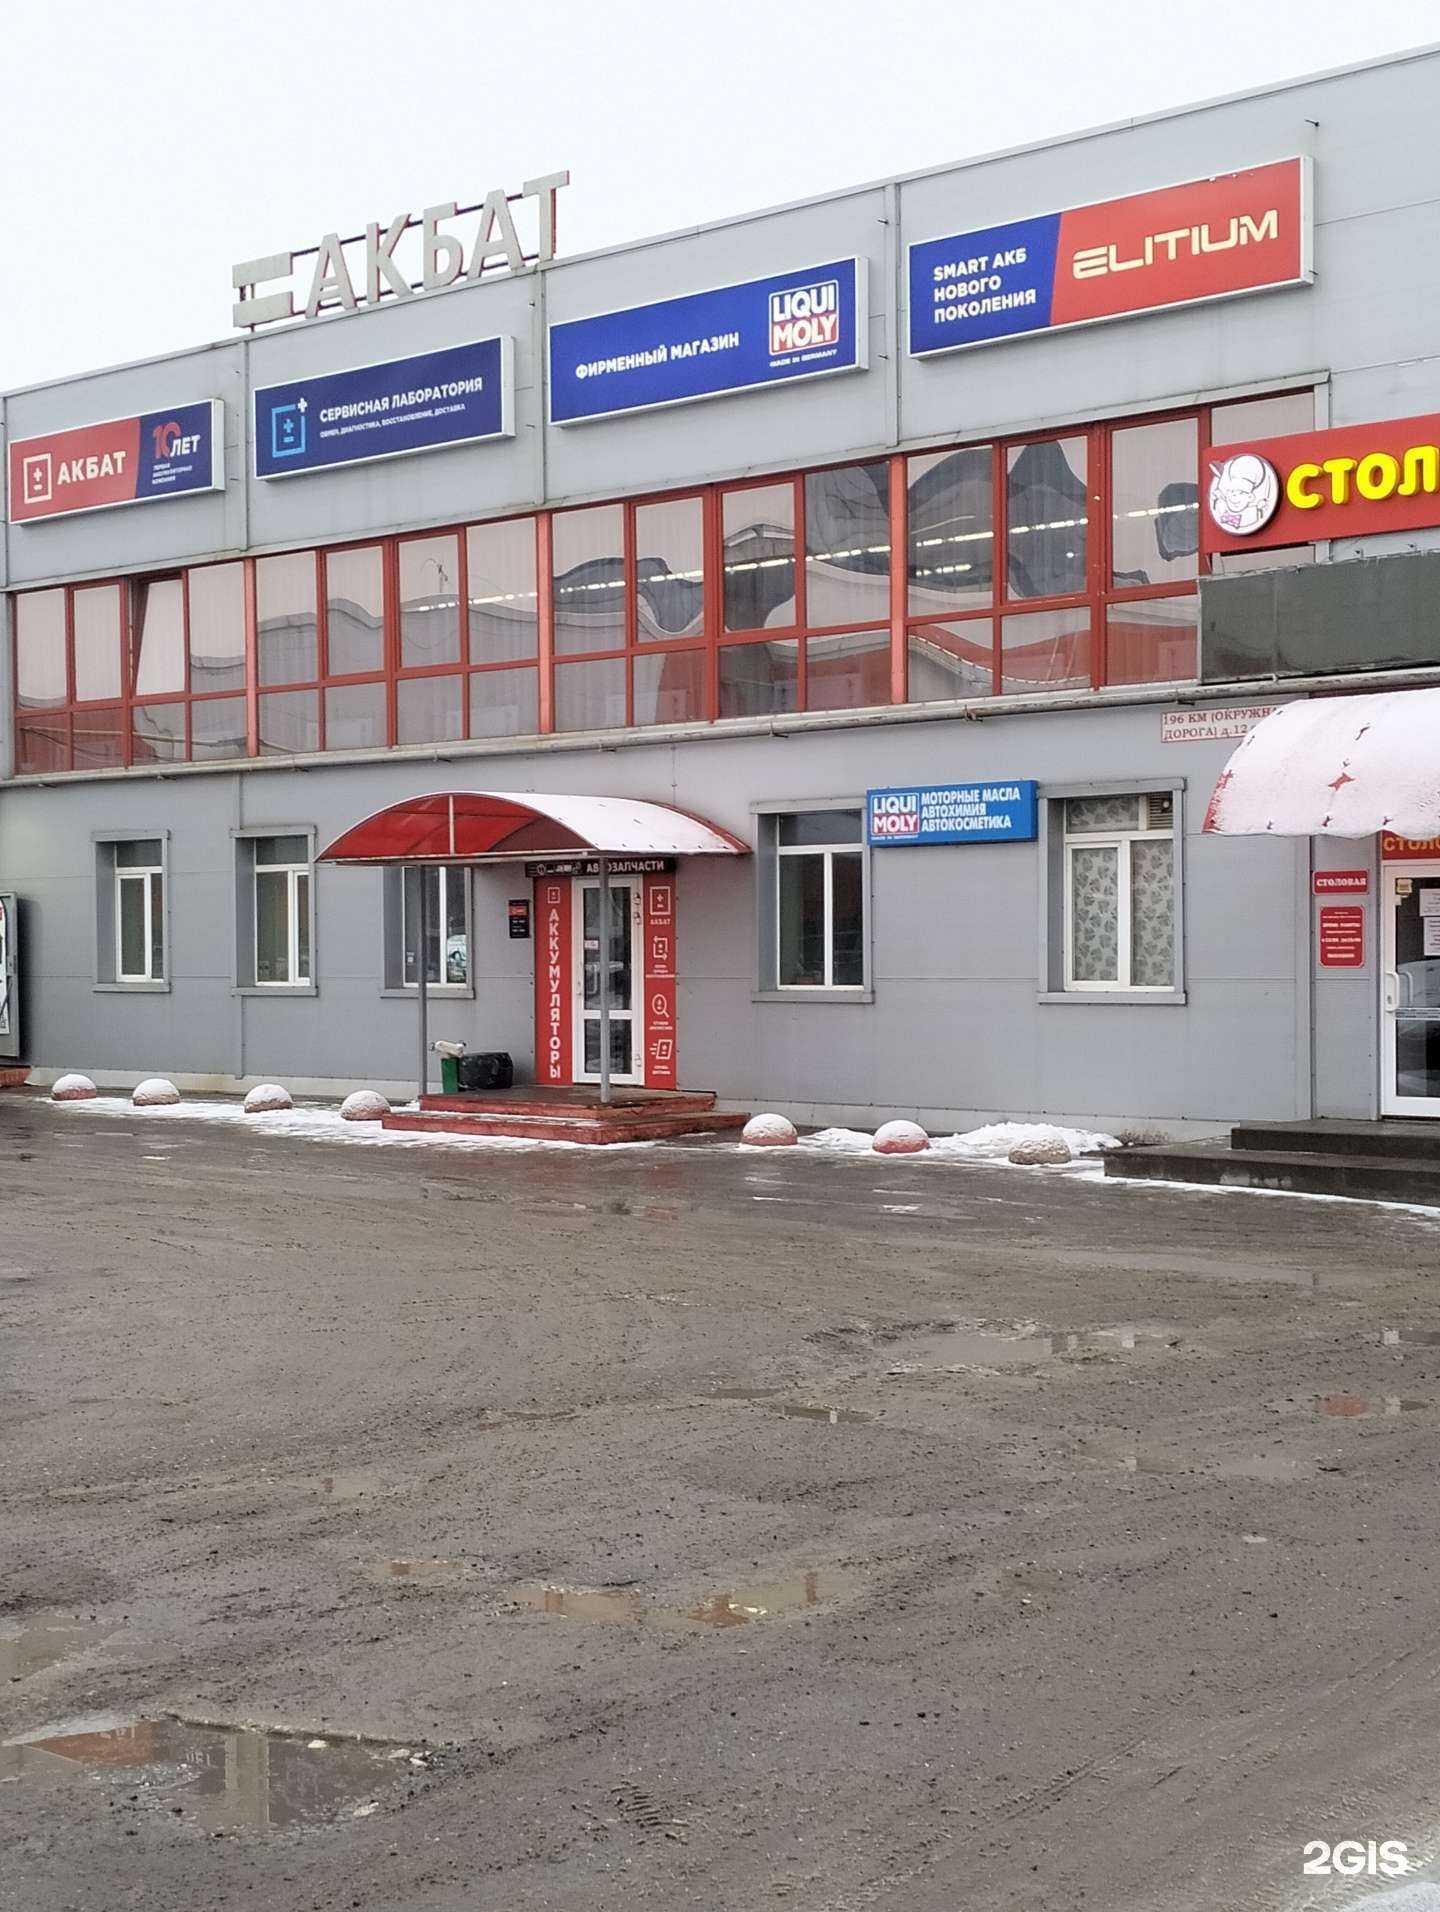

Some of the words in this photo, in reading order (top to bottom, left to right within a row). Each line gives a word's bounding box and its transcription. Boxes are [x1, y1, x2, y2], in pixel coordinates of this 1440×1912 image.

[305, 170, 570, 319] АКБАТ
[1073, 209, 1278, 279] ELITIUM
[934, 256, 988, 281] SMART
[992, 247, 1026, 269] АКБ
[773, 284, 835, 322] LIQUI
[934, 275, 1001, 302] НОВОГО
[934, 288, 1036, 323] ПОКОЛЕНИЯ
[773, 313, 837, 352] MOLY
[575, 345, 668, 380] ФИРМЕННЫЙ
[671, 332, 740, 361] МАГАЗИН
[319, 398, 389, 423] СЕРВИСНАЯ
[391, 377, 483, 408] ЛАБОРАТОРИЯ
[170, 434, 200, 457] ЛЕТ
[57, 450, 126, 485] АКБАТ
[1287, 445, 1440, 508] СТОЛ
[1188, 713, 1207, 723] КМ
[873, 796, 916, 814] LIQUI
[921, 790, 980, 805] МОТОРНЫЕ
[982, 787, 1020, 801] МАСЛА
[921, 803, 986, 819] АВТОХИМИЯ
[873, 815, 917, 833] MOLY
[921, 815, 1012, 832] АВТОКОСМЕТИКА
[586, 861, 664, 873] АВЗАПЧАСТИ
[1316, 878, 1367, 887] СТОЛОВАЯ
[549, 908, 560, 1078] АККУМУЛЯТОРЫ
